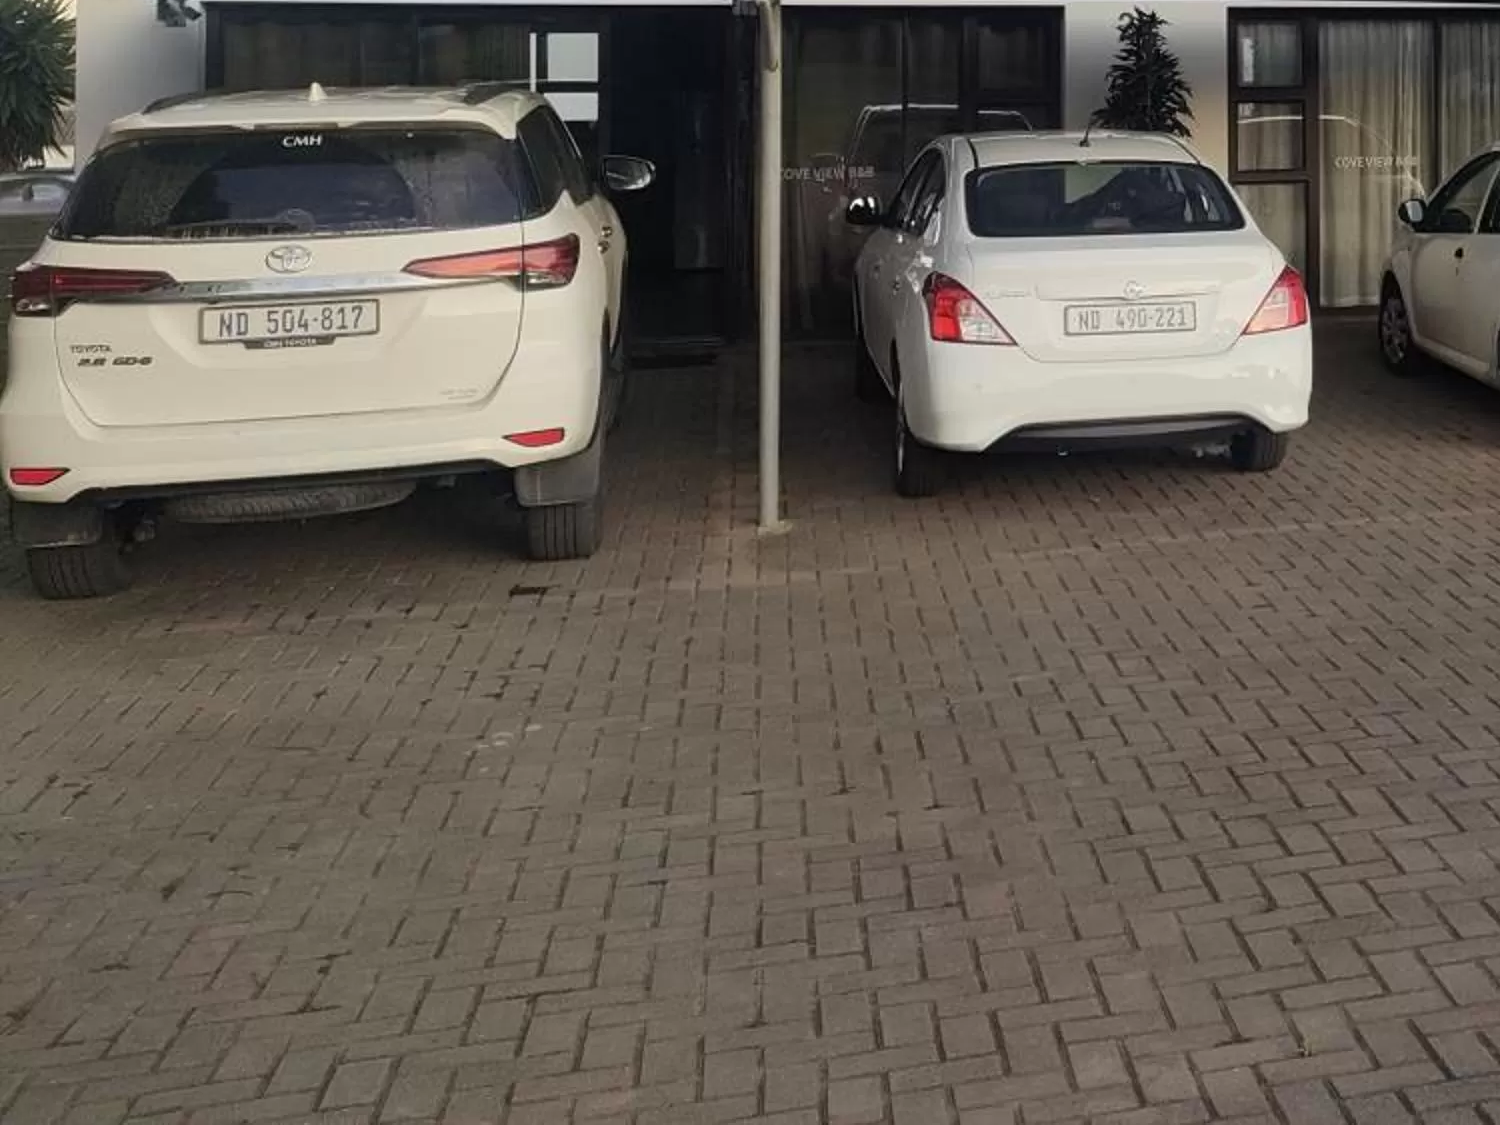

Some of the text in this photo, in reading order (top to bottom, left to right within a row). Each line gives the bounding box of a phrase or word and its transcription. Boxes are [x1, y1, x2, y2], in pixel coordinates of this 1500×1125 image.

[282, 135, 322, 148] CMH
[219, 304, 364, 337] ND 504-817
[1078, 307, 1187, 331] ND 490-221
